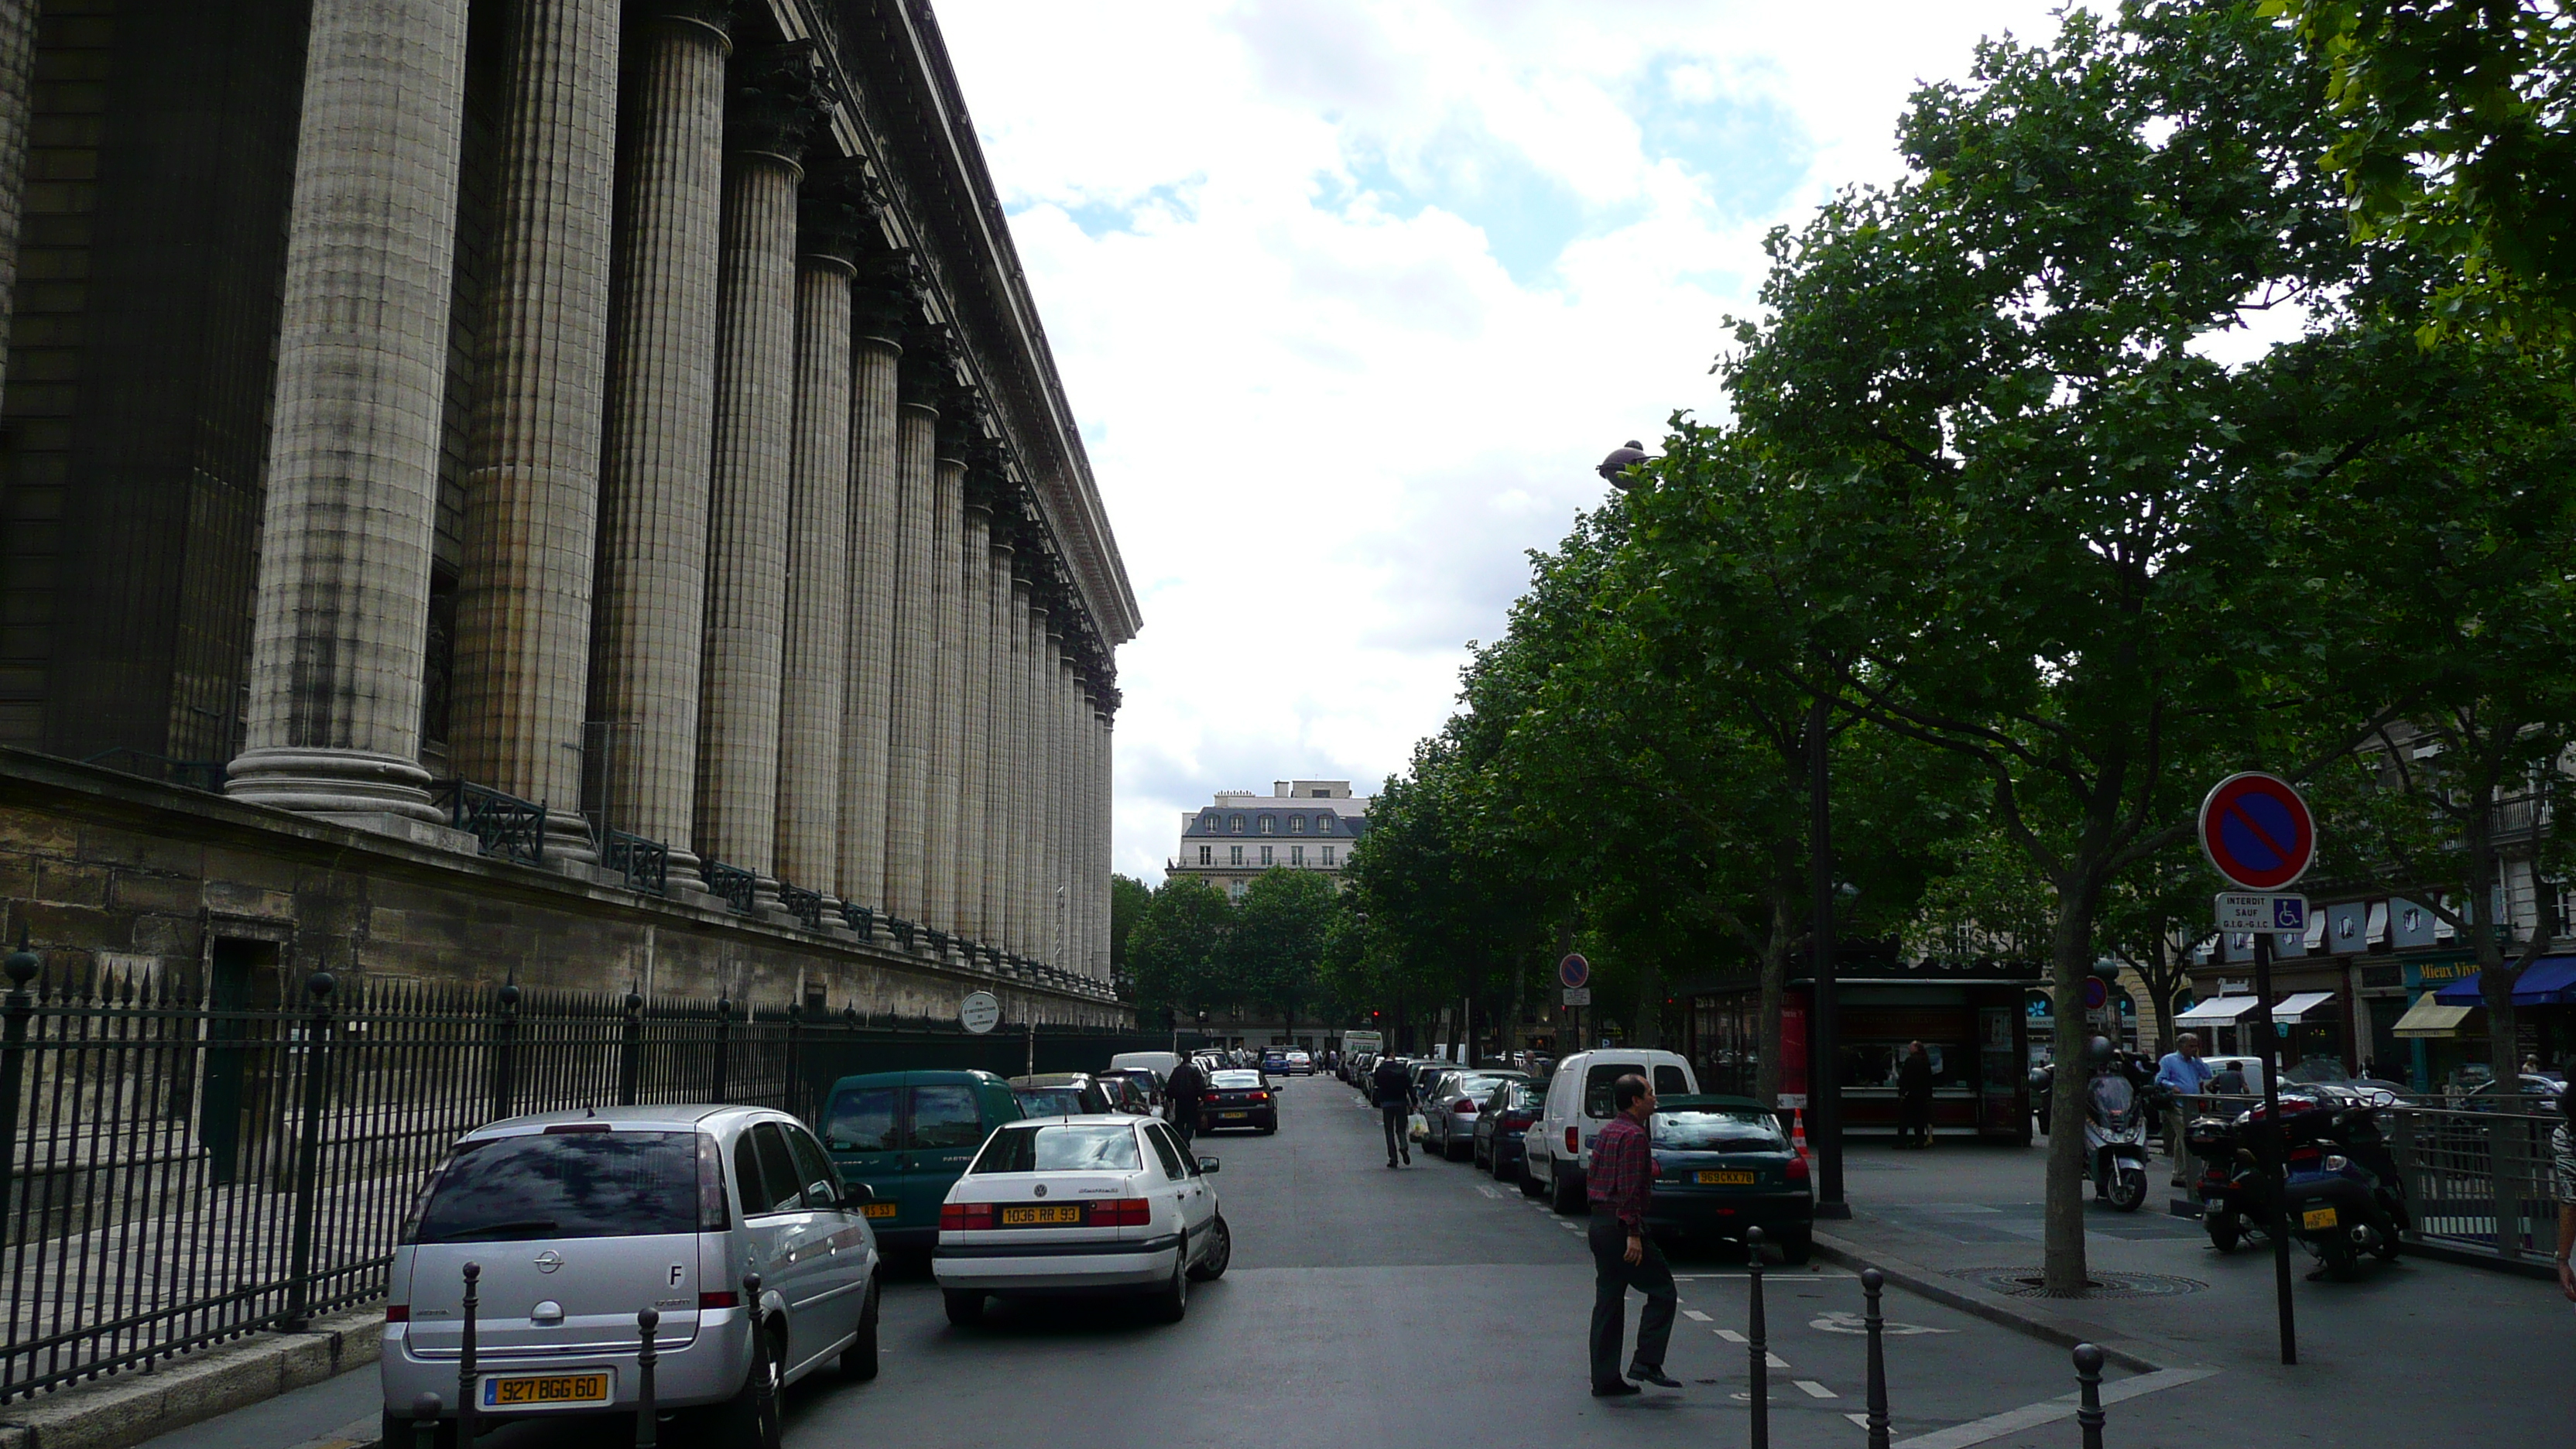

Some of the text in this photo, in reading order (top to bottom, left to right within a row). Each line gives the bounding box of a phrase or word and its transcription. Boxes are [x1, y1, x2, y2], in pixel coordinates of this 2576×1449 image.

[2227, 897, 2265, 906] INTERDIT
[2420, 964, 2453, 978] Mieux
[879, 1204, 889, 1215] 53
[1005, 1207, 1076, 1223] 1036 RR 93
[670, 1266, 682, 1286] F
[503, 1378, 598, 1401] 927 BGG 60
